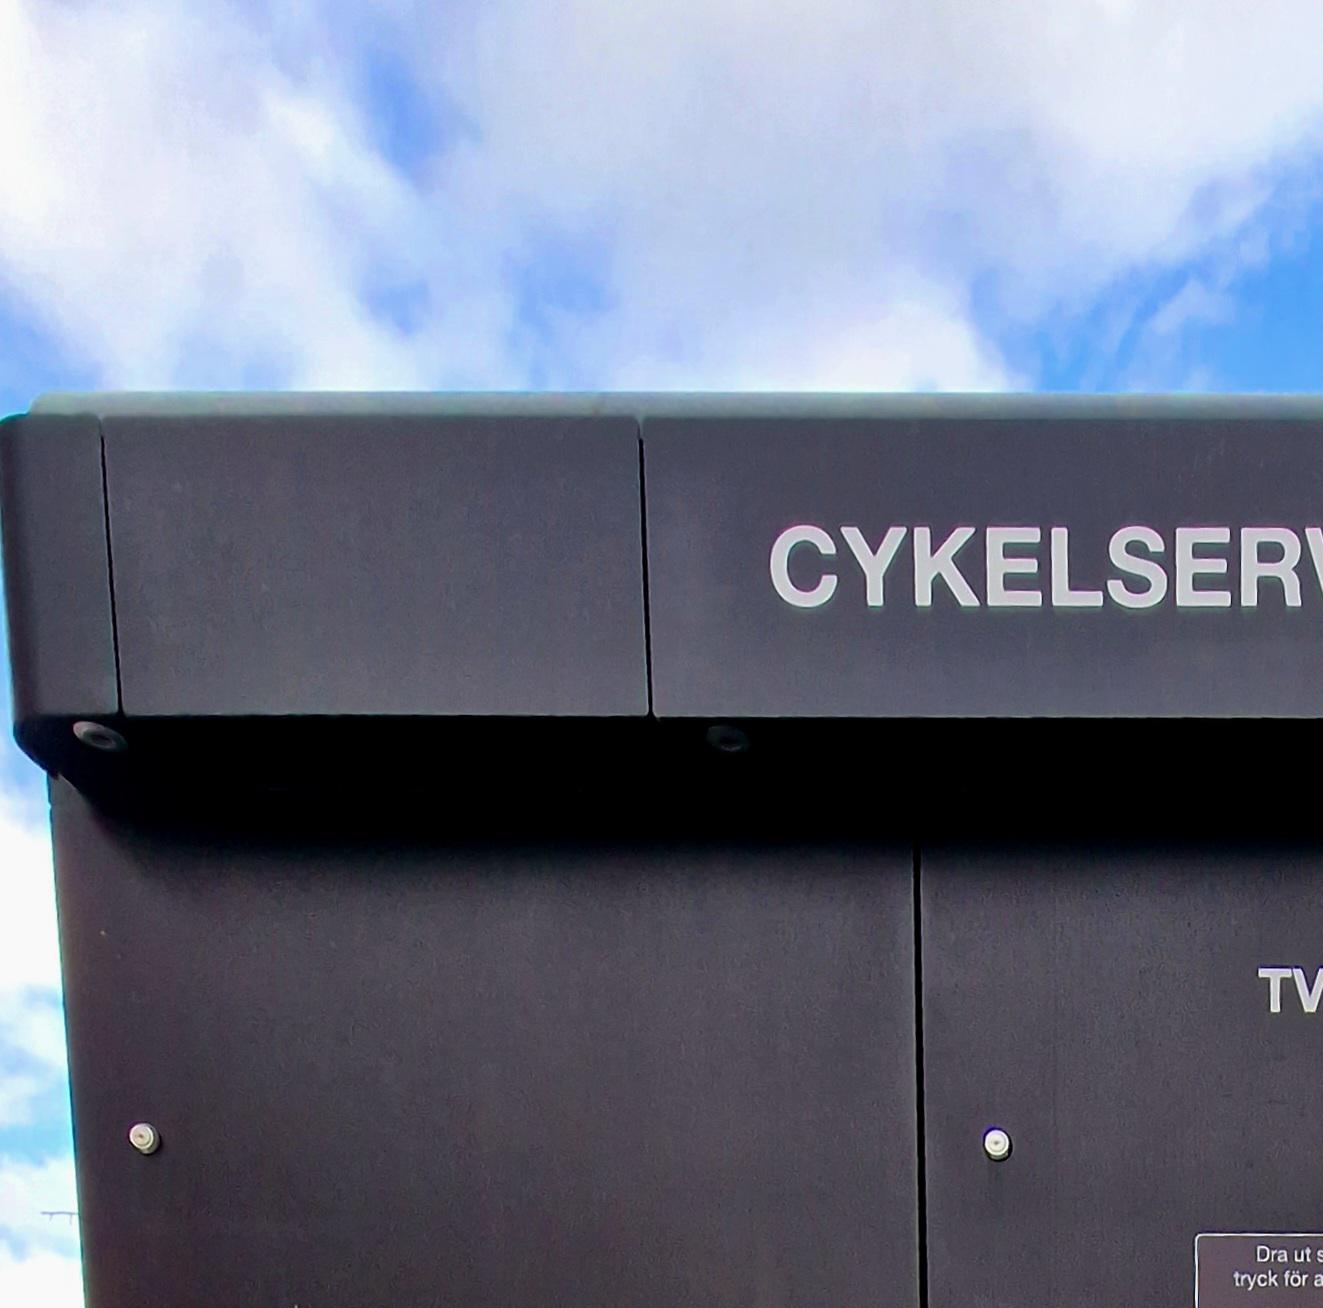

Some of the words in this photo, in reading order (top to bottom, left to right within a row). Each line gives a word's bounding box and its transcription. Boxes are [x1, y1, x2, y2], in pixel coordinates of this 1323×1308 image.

[1256, 1245, 1289, 1263] Dra
[1294, 1246, 1312, 1263] ut
[1233, 1269, 1279, 1292] tryck
[1284, 1269, 1309, 1288] för
